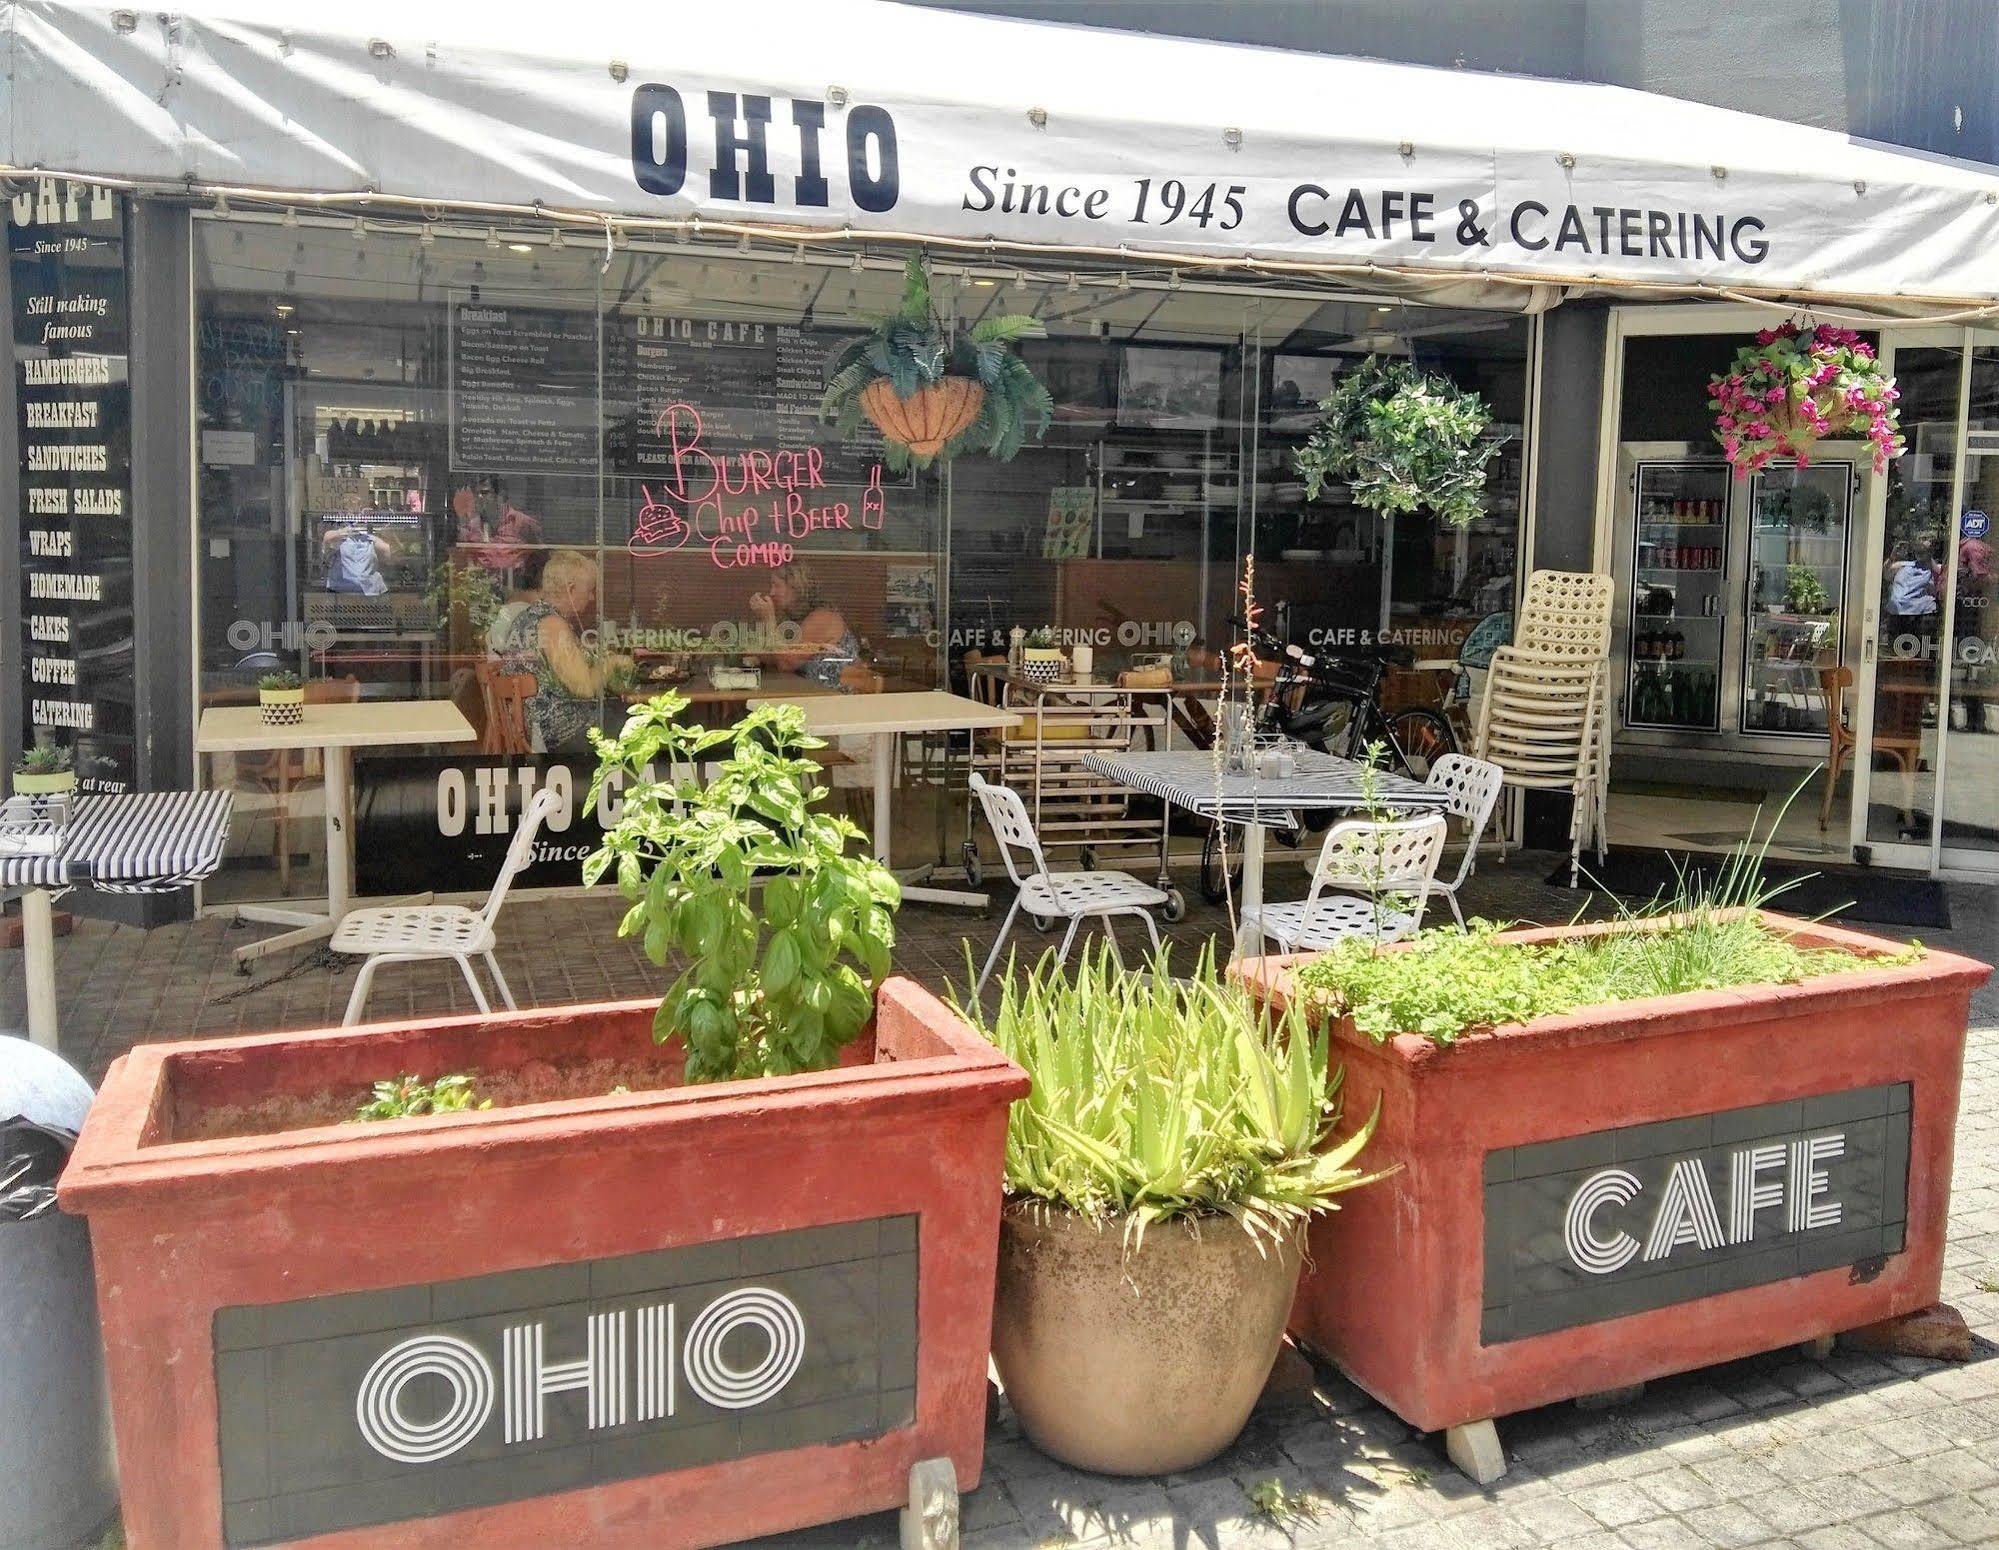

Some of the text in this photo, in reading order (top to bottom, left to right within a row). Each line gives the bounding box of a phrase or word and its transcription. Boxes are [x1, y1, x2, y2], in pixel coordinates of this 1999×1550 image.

[631, 83, 899, 212] OHIO
[961, 165, 1247, 230] Since 1945
[1287, 184, 1770, 264] CAFE & CATERING
[35, 238, 88, 253] Since 1945
[27, 296, 107, 316] Still making
[41, 323, 93, 344] famous
[637, 317, 765, 343] OHIO CAFE
[25, 358, 109, 385] HAMBURGERS
[777, 377, 822, 390] Sandwiches
[26, 402, 98, 428] BREAKFAST
[28, 445, 107, 471] SANDWICHES
[28, 488, 121, 515] FRESH SALADS
[696, 493, 759, 543] Chip
[786, 492, 853, 539] BEER
[1965, 518, 1985, 529] ADT
[29, 531, 72, 557] WRAPS
[711, 535, 795, 569] COMBO
[30, 573, 101, 601] HOMEMADE
[30, 615, 69, 642] CAKES
[227, 620, 338, 650] OHIO
[581, 628, 701, 649] CATERING
[710, 620, 801, 648] OHIO
[926, 628, 985, 648] CAFE
[992, 629, 1004, 647] &
[1117, 620, 1196, 647] OHIO
[1309, 628, 1464, 646] CAFE & CATERING
[31, 657, 76, 685] COFFEE
[32, 699, 93, 729] CATERING
[82, 777, 96, 790] at
[98, 780, 126, 793] rear
[437, 765, 574, 837] OHIO
[527, 840, 591, 864] Since
[1564, 1133, 1846, 1275] CAFE
[356, 1286, 806, 1464] OHIO
